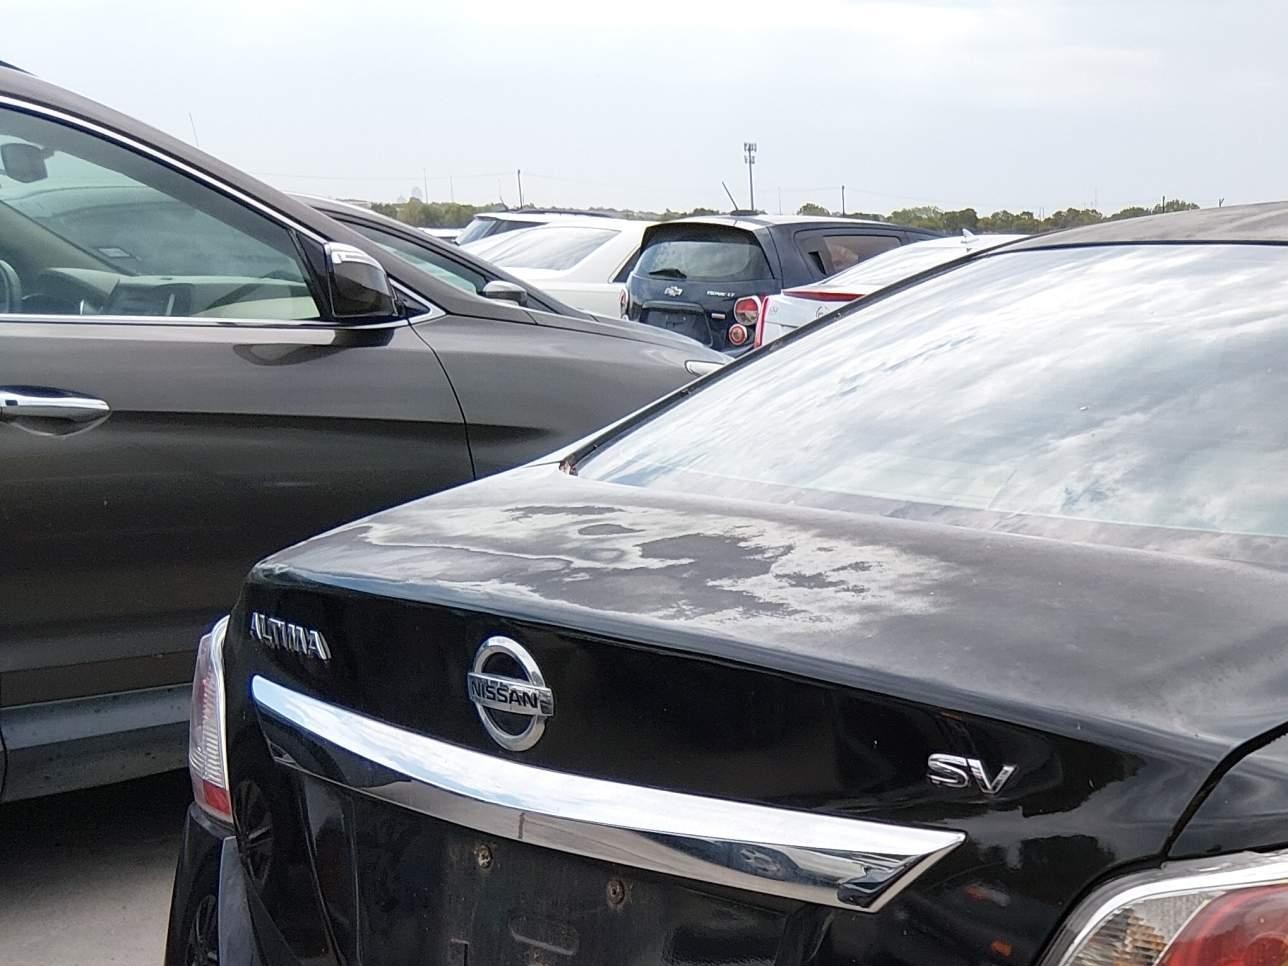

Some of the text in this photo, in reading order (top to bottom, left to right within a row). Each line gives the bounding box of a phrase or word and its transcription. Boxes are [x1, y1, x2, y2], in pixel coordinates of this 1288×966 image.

[250, 612, 332, 661] ALTIMA
[471, 680, 539, 709] NISSAN
[927, 753, 1015, 794] SV
